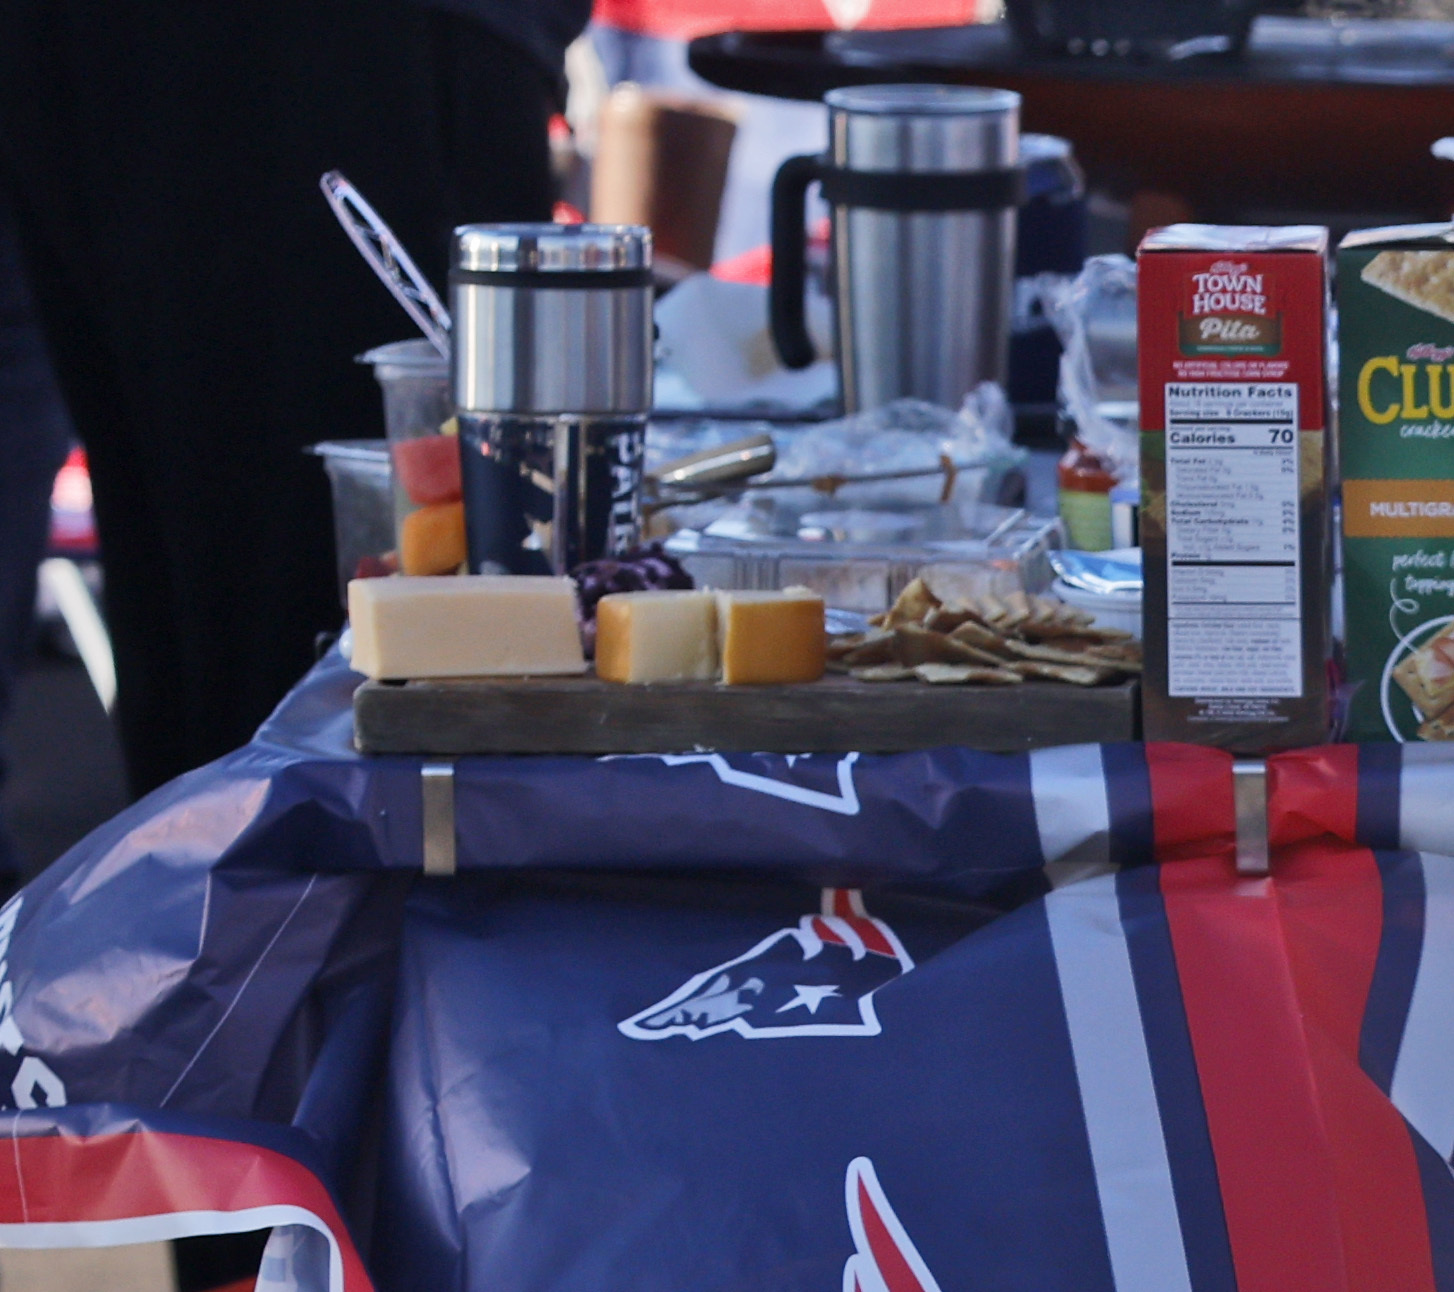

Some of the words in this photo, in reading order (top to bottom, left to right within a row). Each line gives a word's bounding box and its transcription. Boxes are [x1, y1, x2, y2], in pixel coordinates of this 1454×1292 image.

[1192, 273, 1264, 293] TOWN
[1192, 292, 1267, 315] HOUSE
[1199, 317, 1261, 341] Pita
[1168, 386, 1242, 398] Nutrition
[1247, 386, 1293, 398] Facts
[1169, 431, 1236, 444] Calories
[1268, 429, 1294, 444] 70
